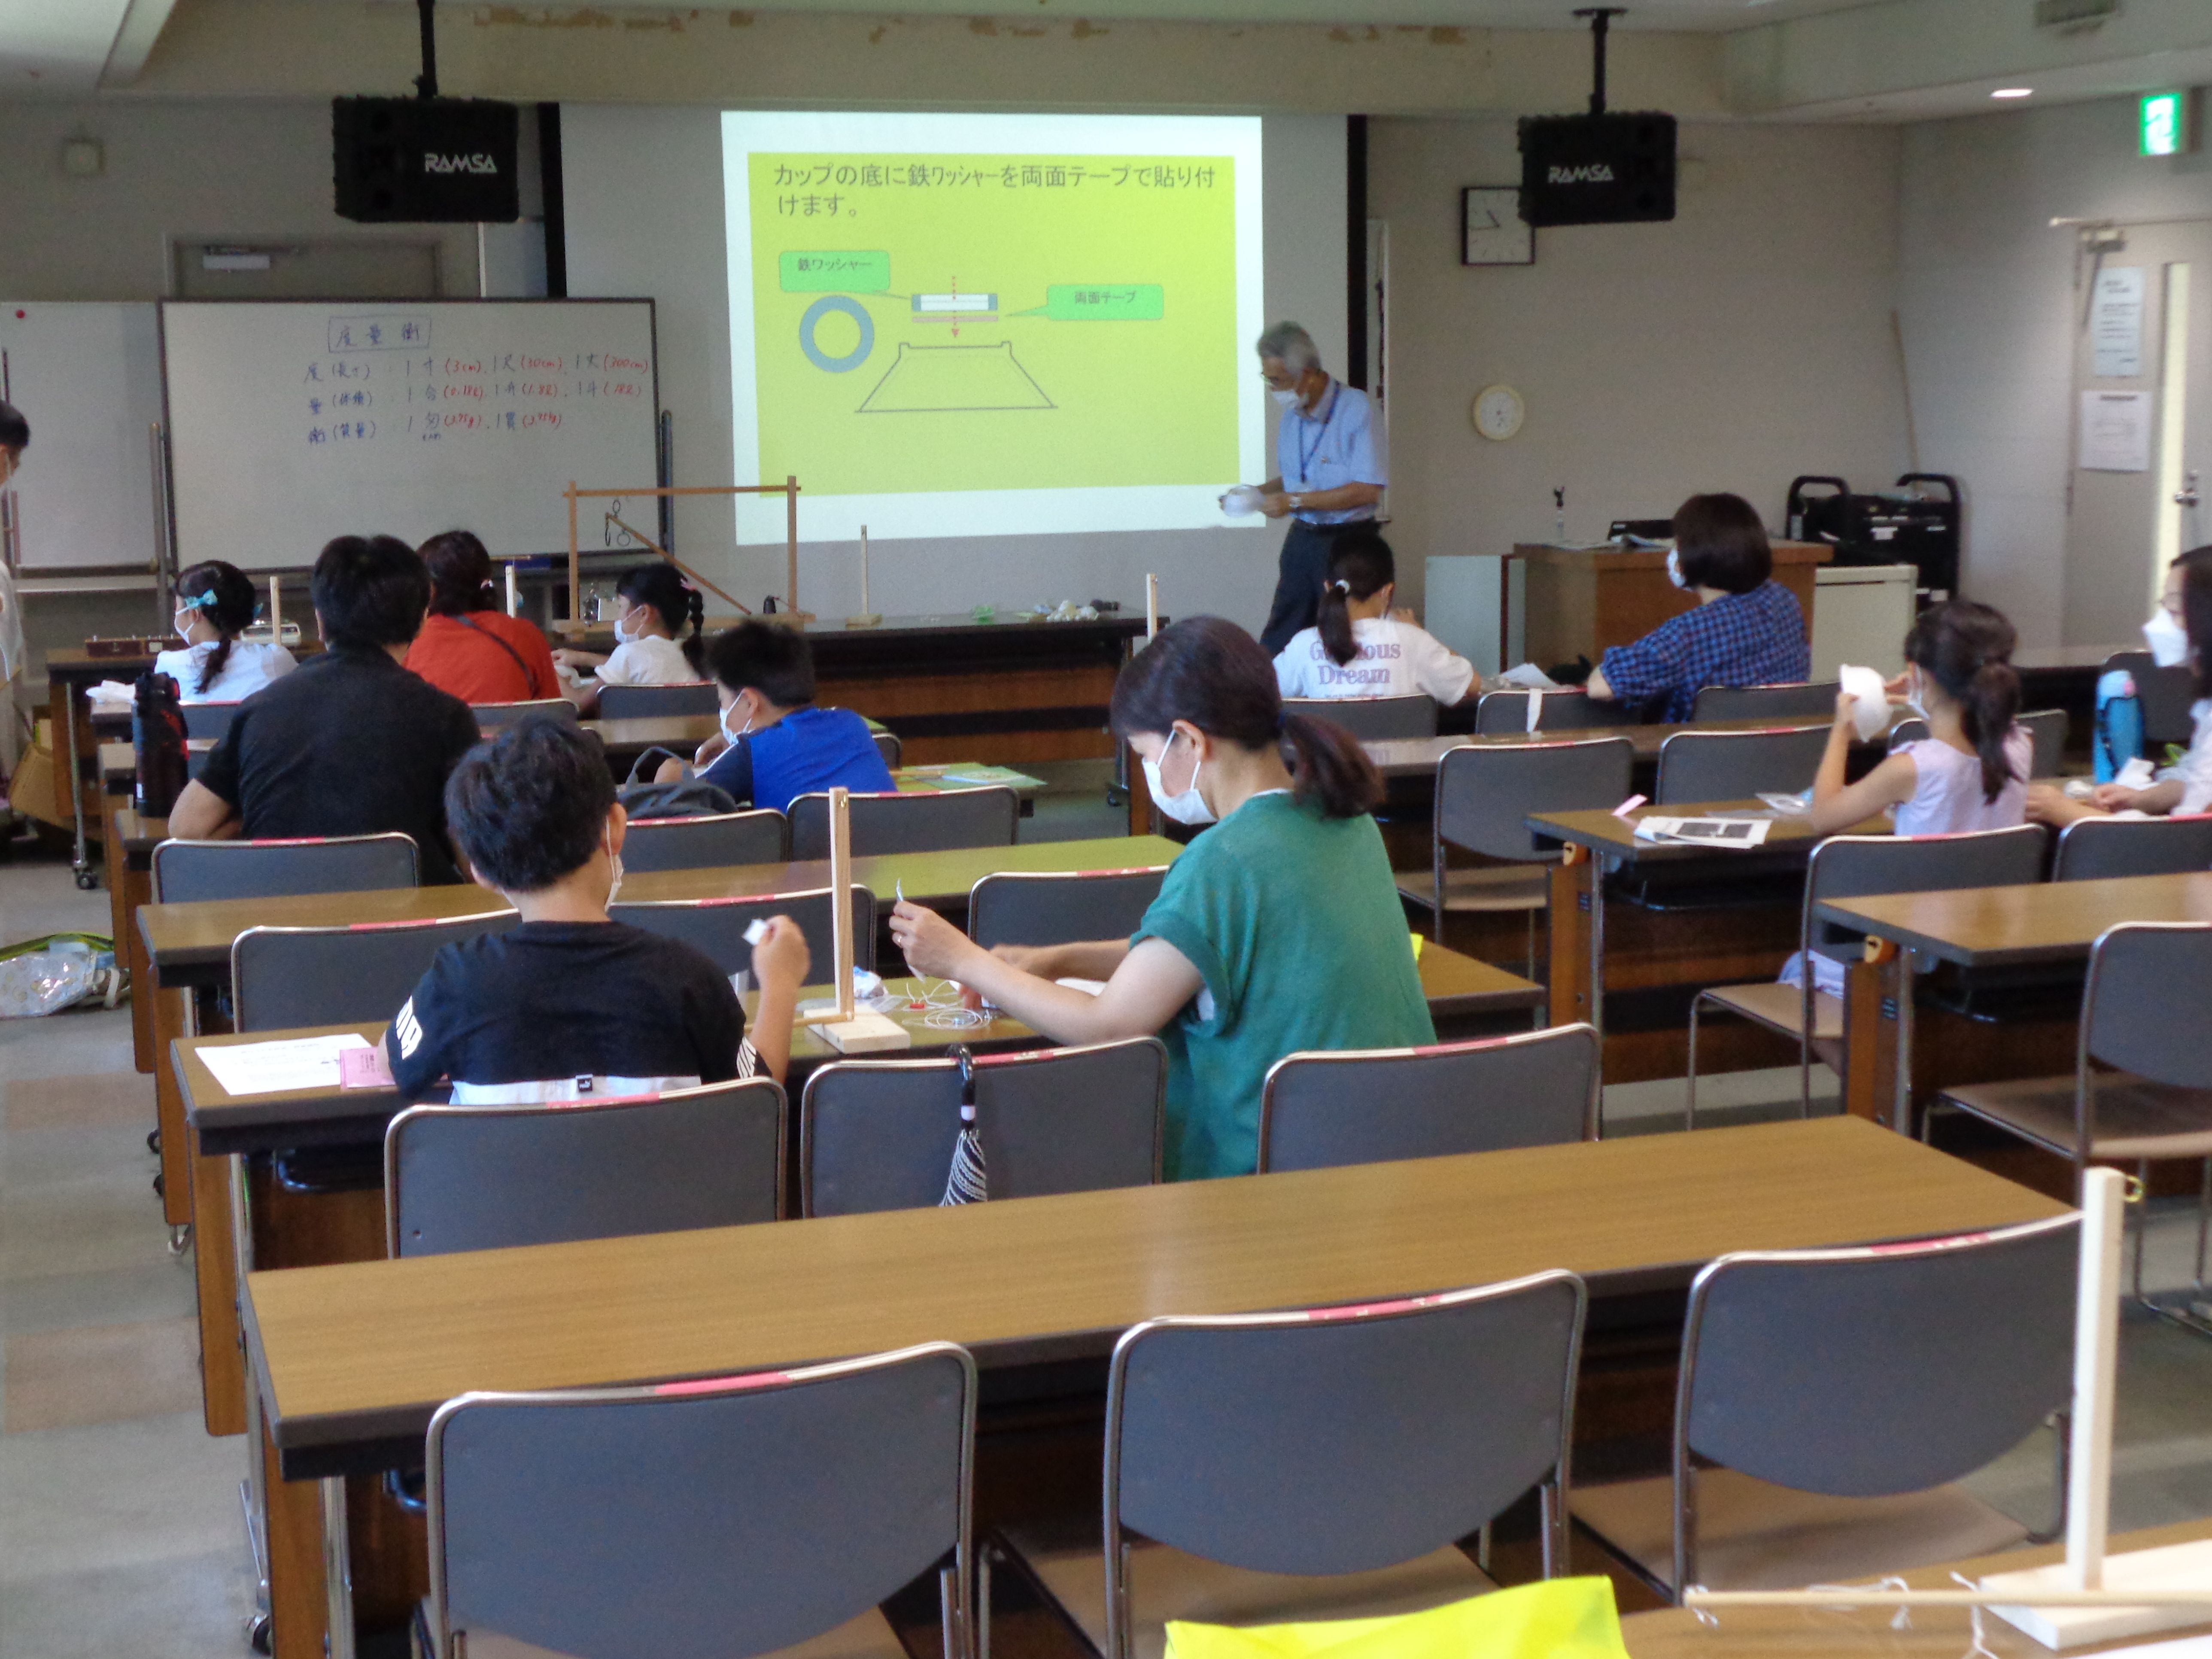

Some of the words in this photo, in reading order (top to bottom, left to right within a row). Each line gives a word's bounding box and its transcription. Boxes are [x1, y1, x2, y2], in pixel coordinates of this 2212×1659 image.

[424, 153, 497, 172] RAMSA
[1548, 164, 1613, 183] RAMSA
[778, 192, 857, 217] けます。
[798, 258, 872, 271] 鉄ワッシャー
[1074, 290, 1137, 304] 両面テープ
[1318, 665, 1390, 685] Dream
